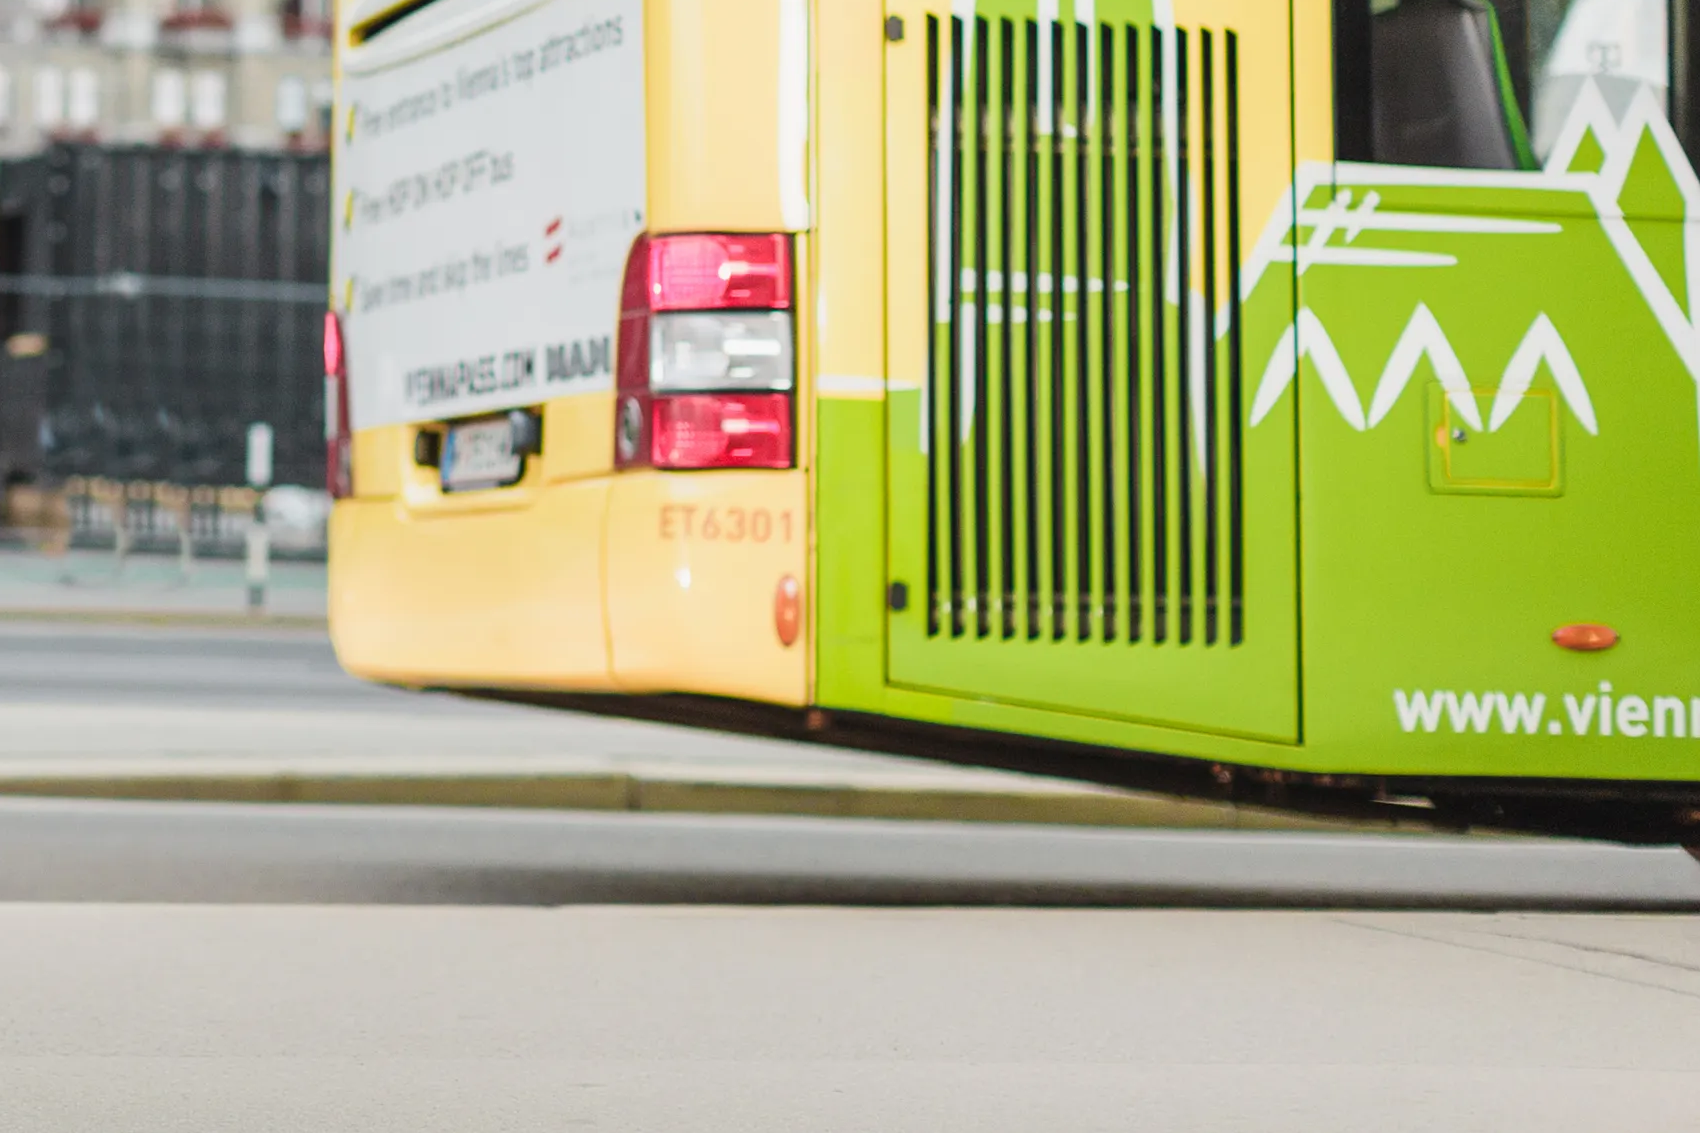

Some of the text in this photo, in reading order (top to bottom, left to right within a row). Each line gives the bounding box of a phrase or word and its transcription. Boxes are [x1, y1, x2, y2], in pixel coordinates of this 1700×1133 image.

[539, 14, 623, 72] attractions
[658, 503, 793, 546] ET6301
[1393, 679, 1700, 740] www.vien
